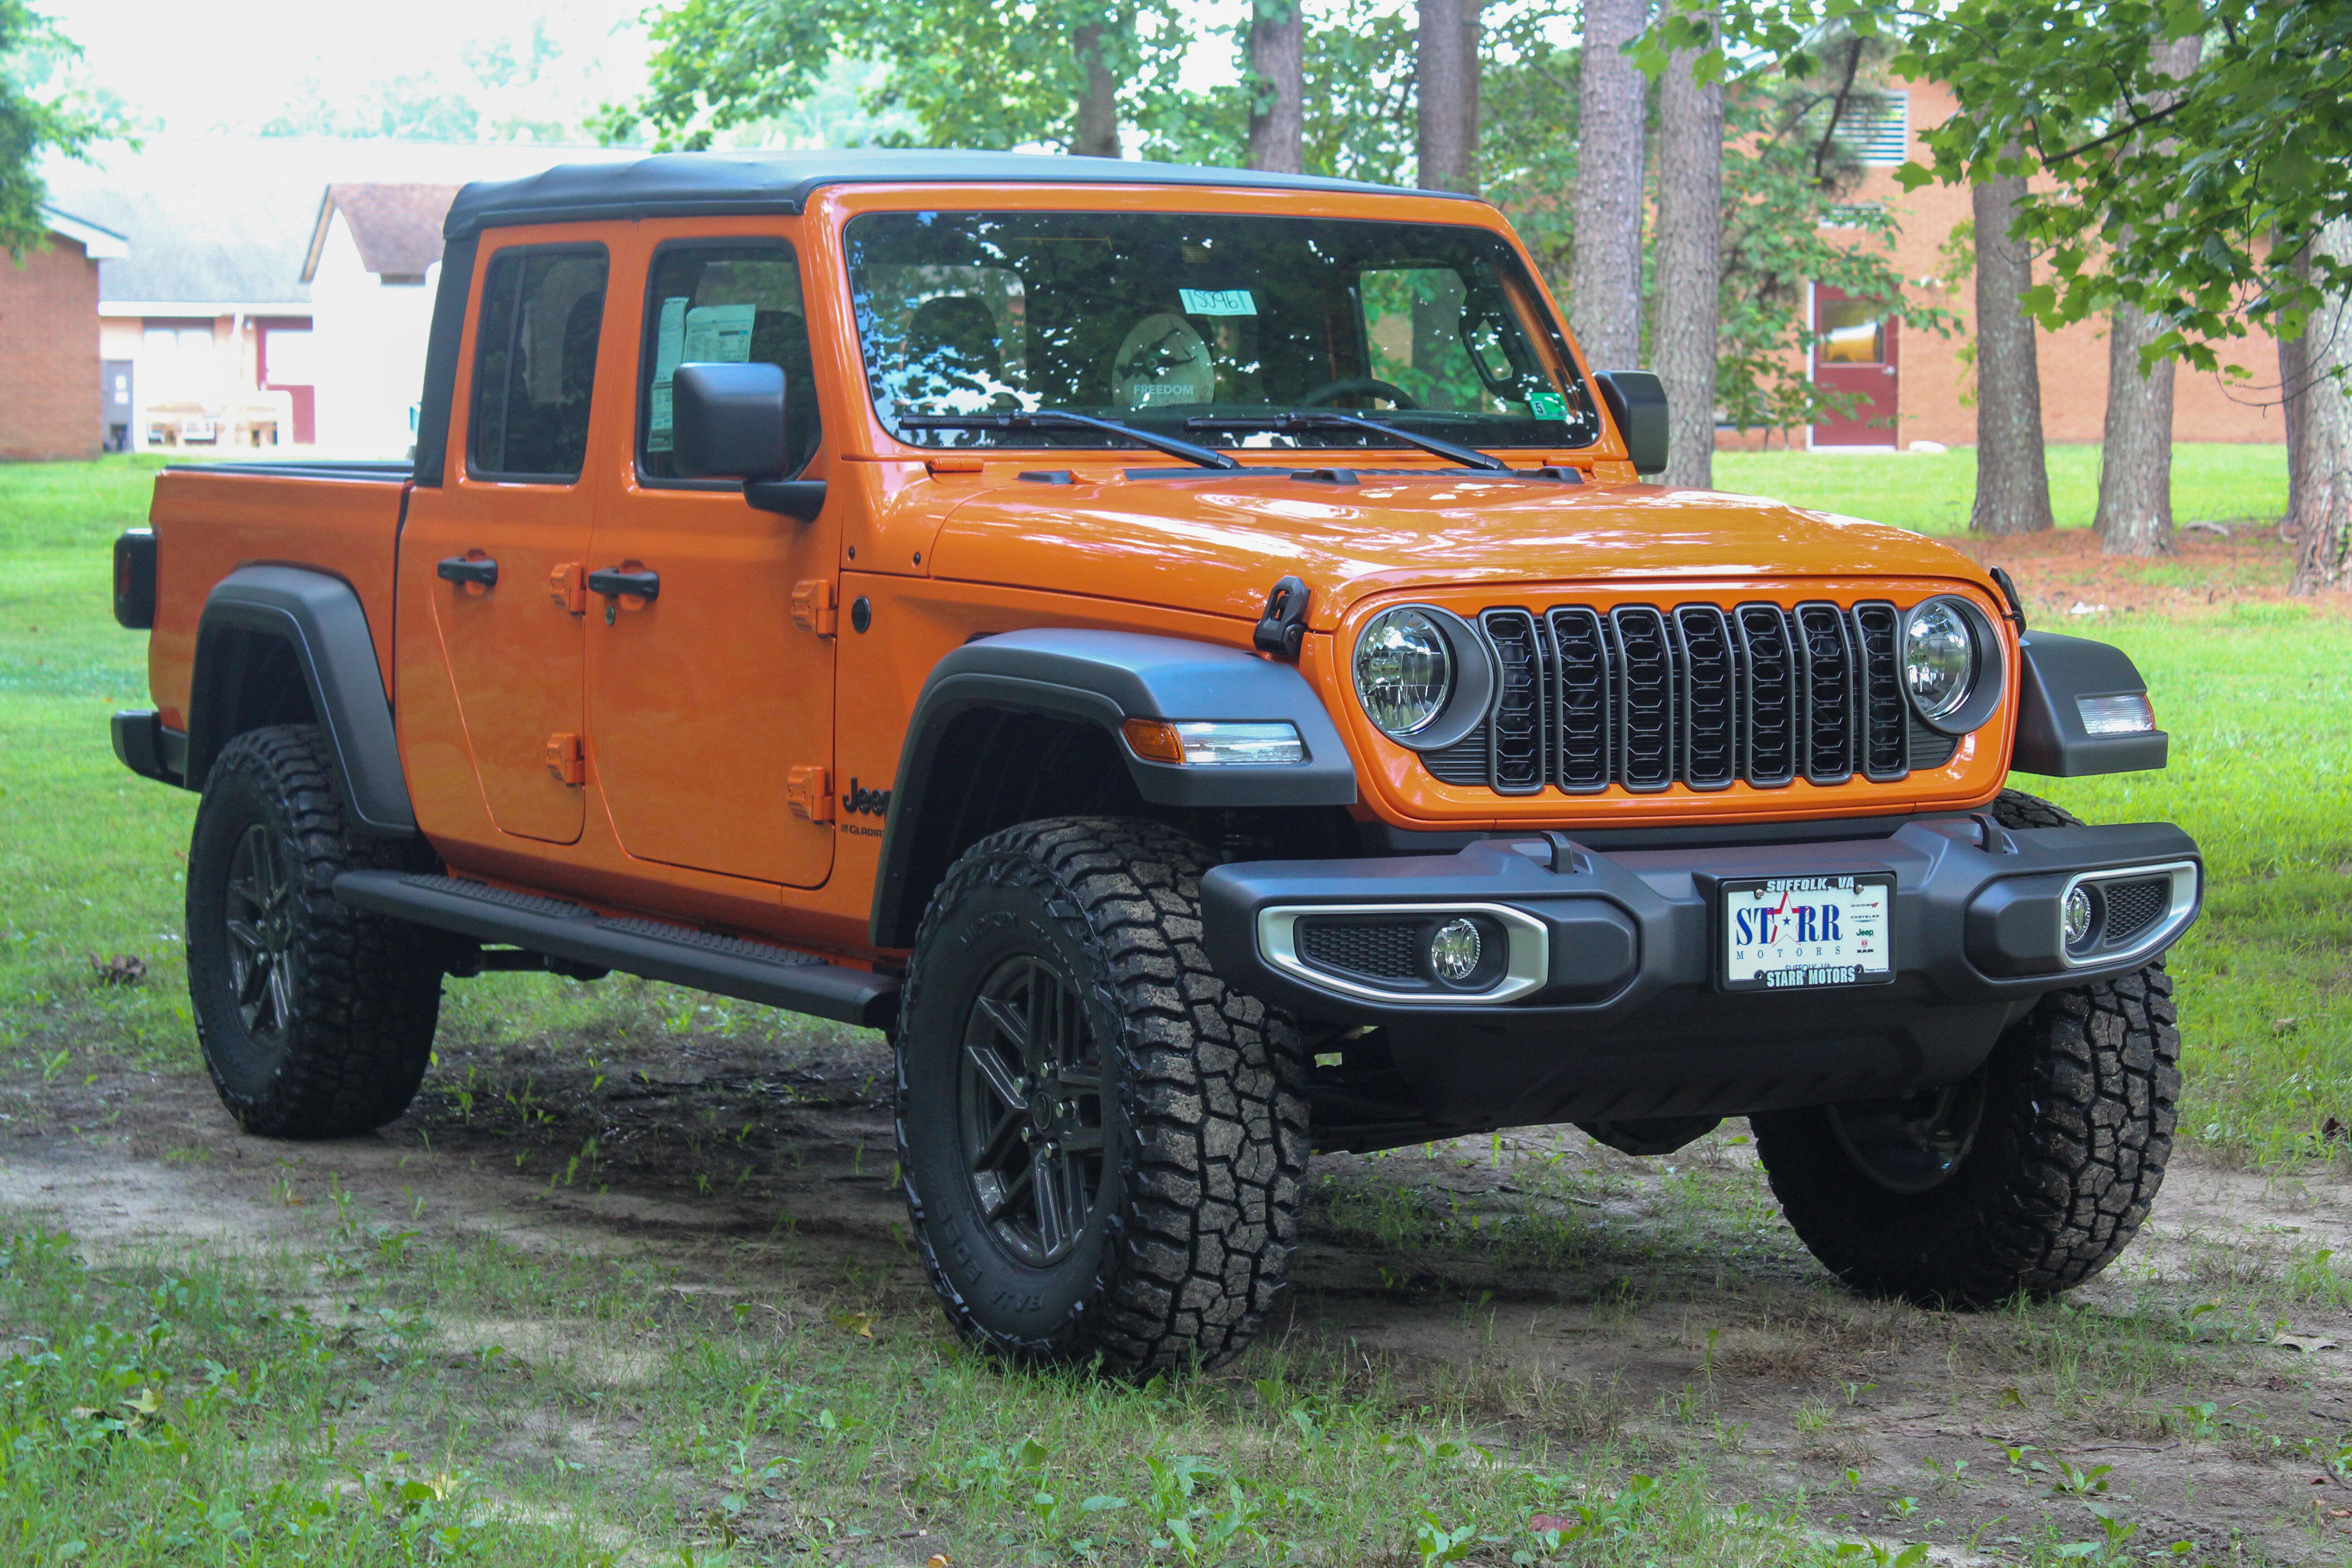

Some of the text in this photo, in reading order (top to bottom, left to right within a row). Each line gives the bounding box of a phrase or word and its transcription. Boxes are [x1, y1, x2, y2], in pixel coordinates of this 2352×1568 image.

[1133, 384, 1194, 395] FREEDOM
[1535, 402, 1544, 414] 5
[850, 825, 883, 838] GLADIA
[1838, 877, 1854, 888] VA
[1856, 929, 1874, 937] Jeep
[1736, 946, 1841, 960] MOTORS
[1766, 967, 1856, 988] STARR MOTORS
